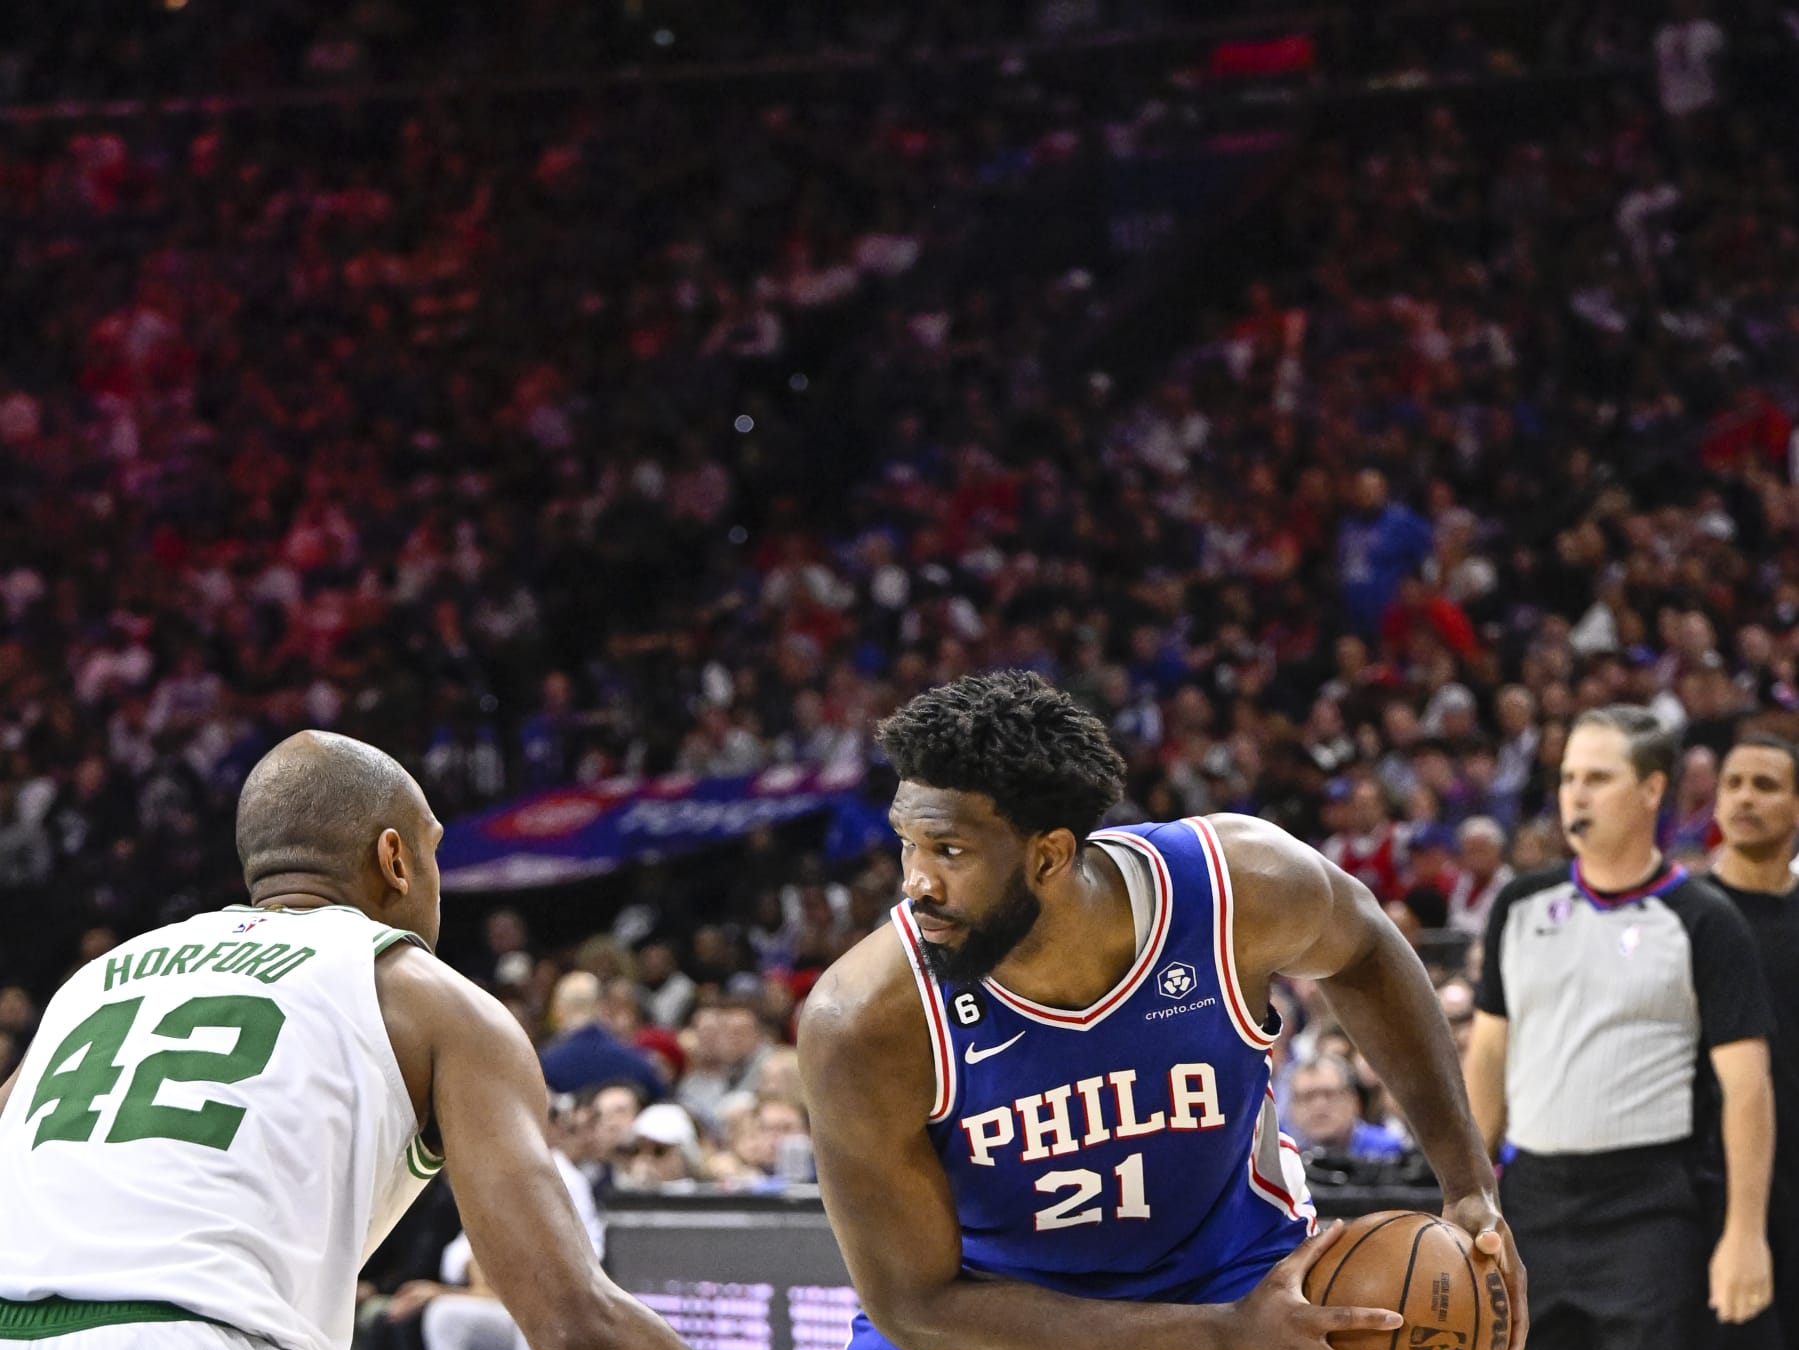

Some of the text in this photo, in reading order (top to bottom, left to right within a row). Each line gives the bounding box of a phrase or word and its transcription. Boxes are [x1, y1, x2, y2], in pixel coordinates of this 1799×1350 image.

[103, 941, 317, 992] HORFORD
[954, 993, 980, 1025] 6
[1145, 997, 1216, 1021] crypto.com
[25, 995, 286, 1151] 42
[961, 1062, 1226, 1167] PHILA
[1034, 1152, 1151, 1232] 21
